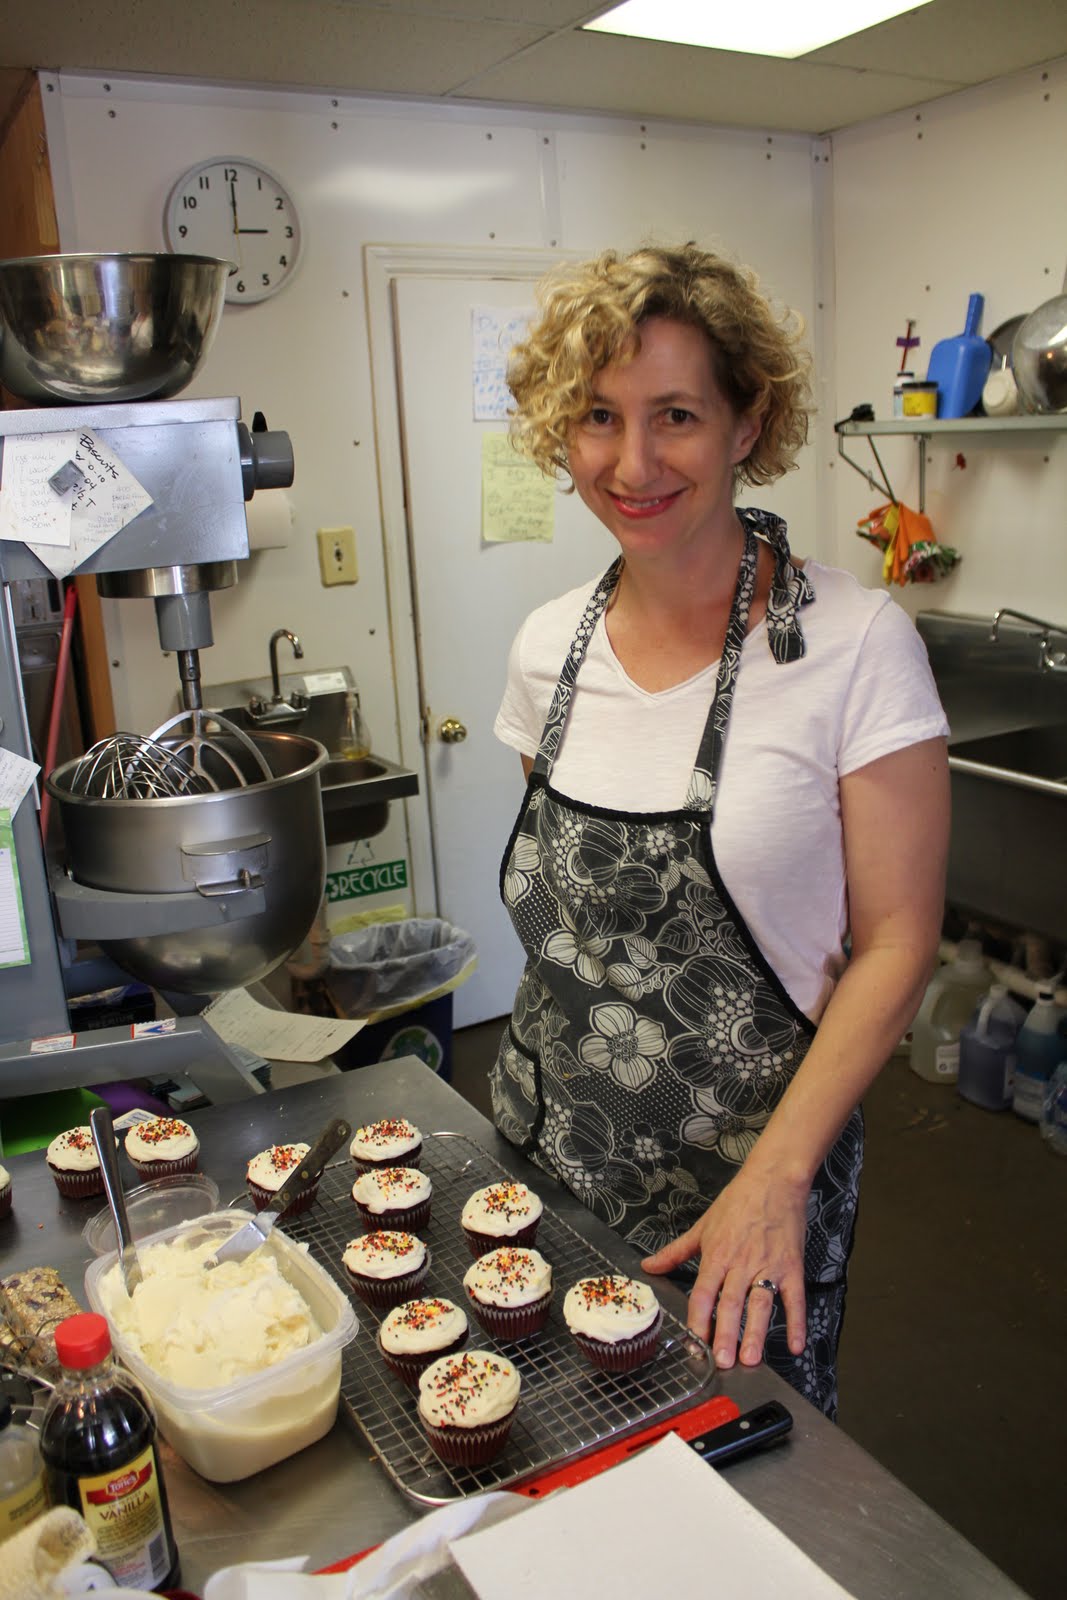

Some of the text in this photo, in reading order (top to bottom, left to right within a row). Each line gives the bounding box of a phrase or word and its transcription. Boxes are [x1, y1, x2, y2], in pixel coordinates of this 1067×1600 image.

[225, 168, 238, 182] 12
[199, 176, 209, 190] 11
[257, 177, 262, 190] 1
[183, 196, 197, 209] 10
[275, 198, 284, 210] 2
[178, 225, 188, 238] 9
[285, 226, 293, 238] 3
[279, 255, 287, 267] 4
[262, 273, 270, 286] 5
[237, 281, 245, 293] 6
[79, 433, 119, 480] Biscuits
[86, 498, 96, 508] T
[338, 864, 405, 896] RECYCLE
[99, 1491, 150, 1521] VANILLA
